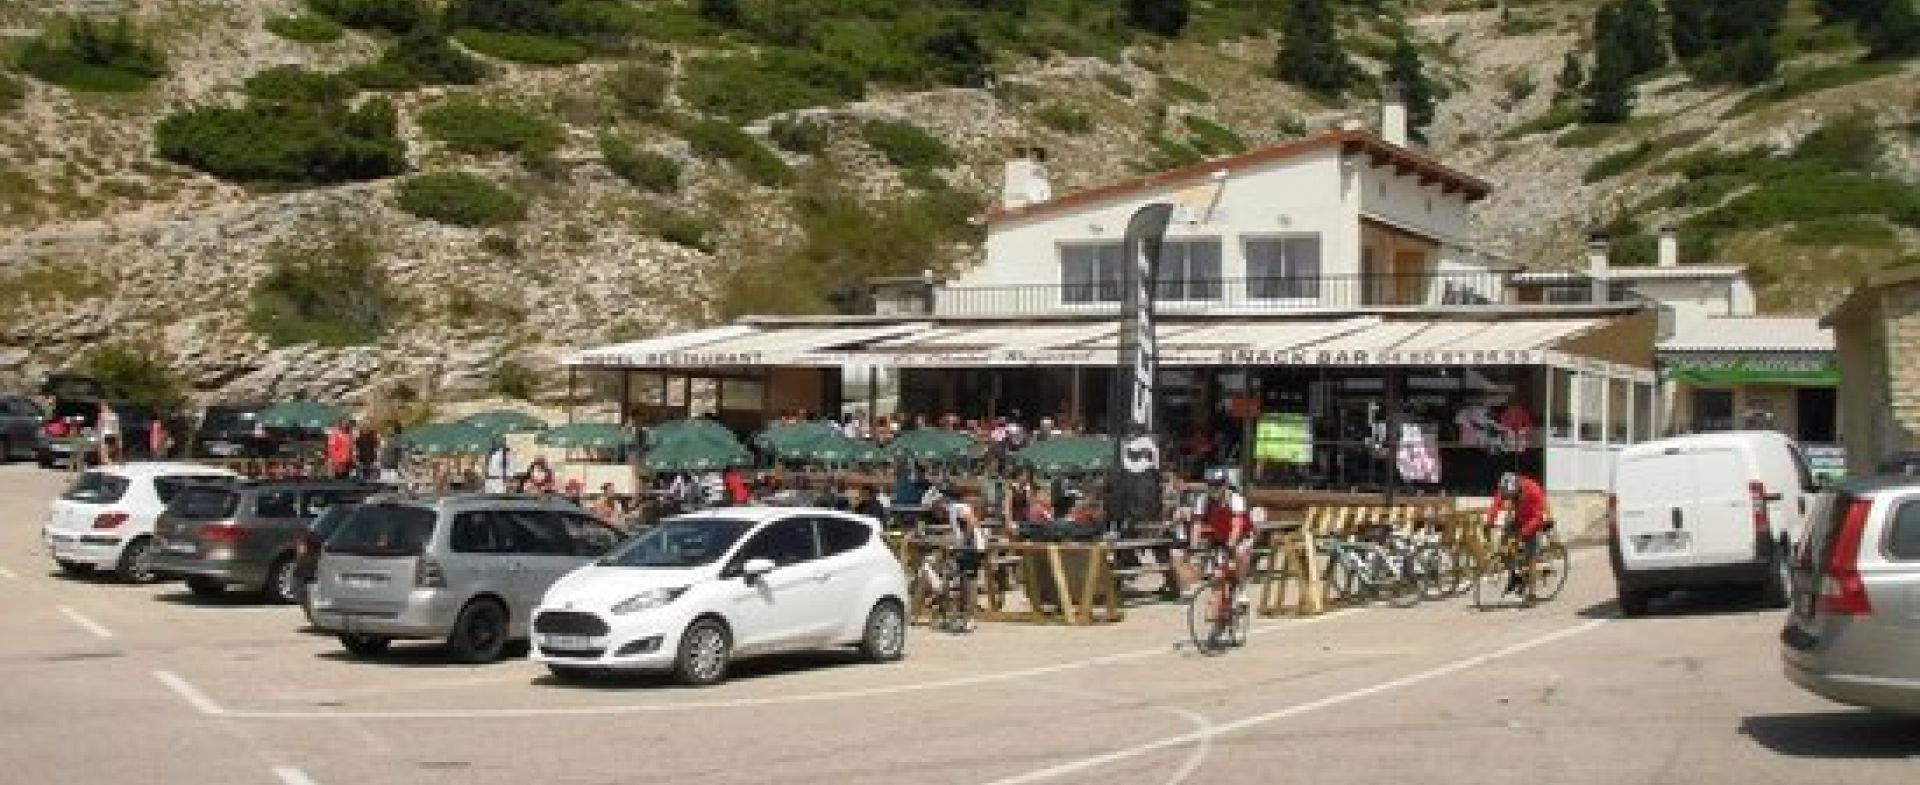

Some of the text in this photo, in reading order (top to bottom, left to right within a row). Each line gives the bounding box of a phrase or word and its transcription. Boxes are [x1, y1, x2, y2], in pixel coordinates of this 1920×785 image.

[1133, 238, 1153, 431] SCOTT
[648, 352, 763, 365] RESTAURANT
[1219, 349, 1307, 364] SNACK
[1316, 349, 1369, 364] BAR
